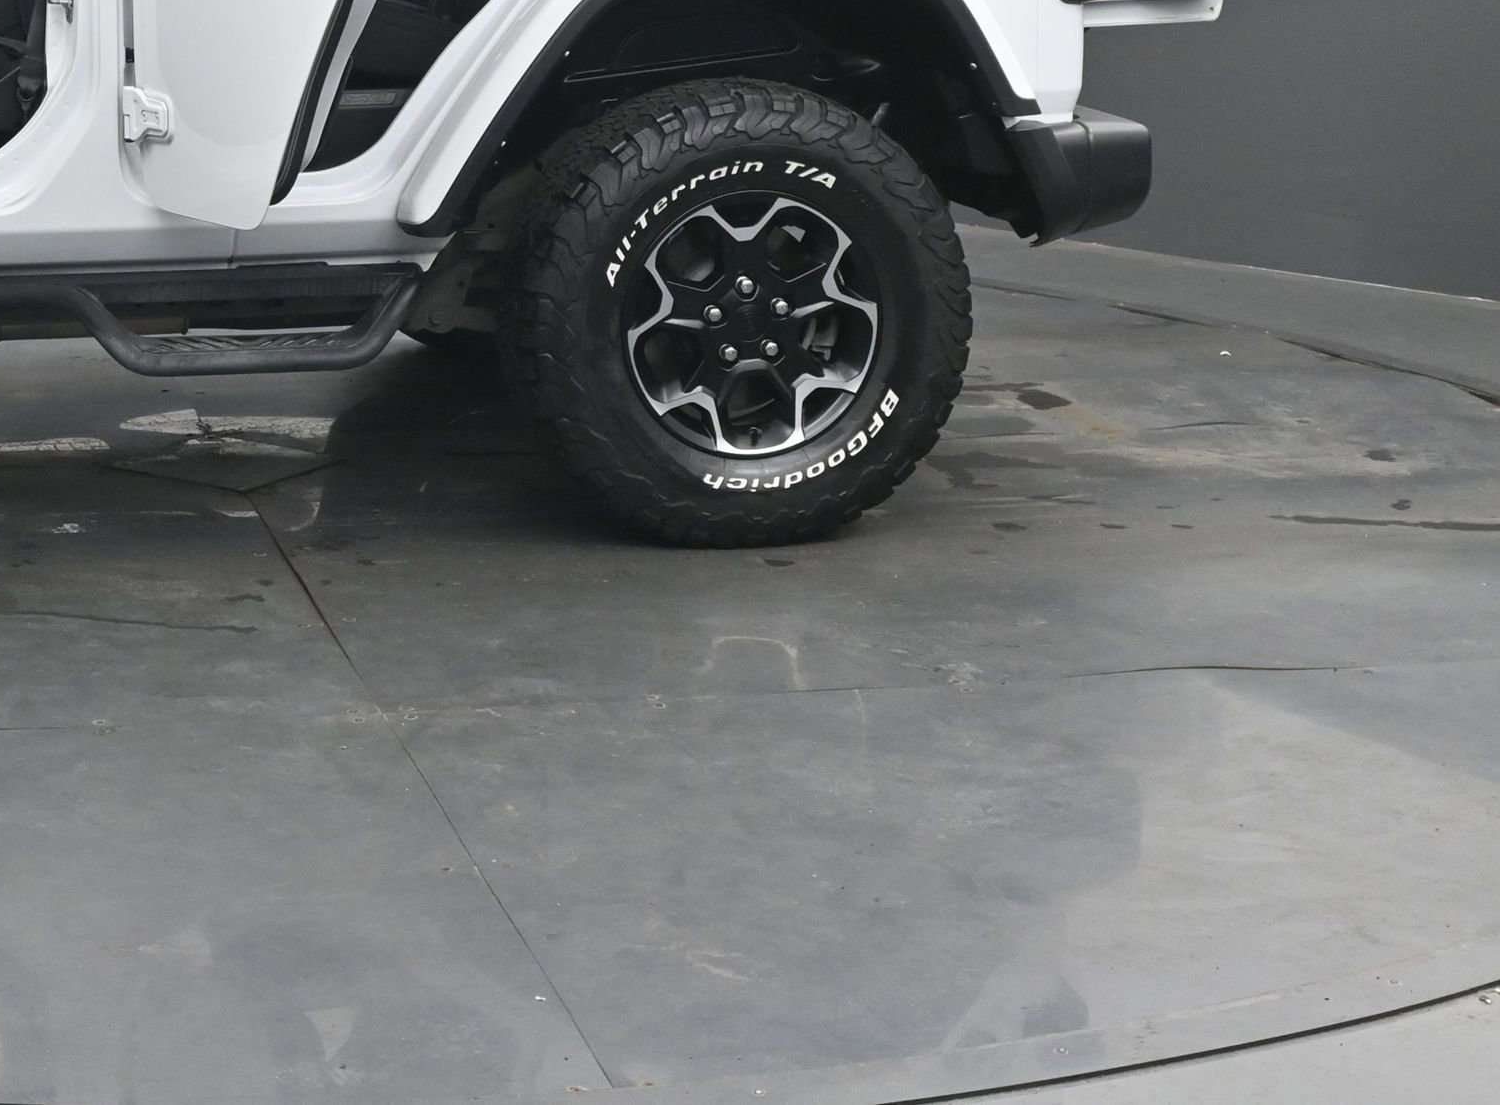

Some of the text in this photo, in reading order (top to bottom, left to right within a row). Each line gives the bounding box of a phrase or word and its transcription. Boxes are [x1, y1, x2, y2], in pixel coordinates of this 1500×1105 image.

[606, 160, 837, 288] All-Terrain T/A
[703, 388, 900, 493] BFGoodrich
